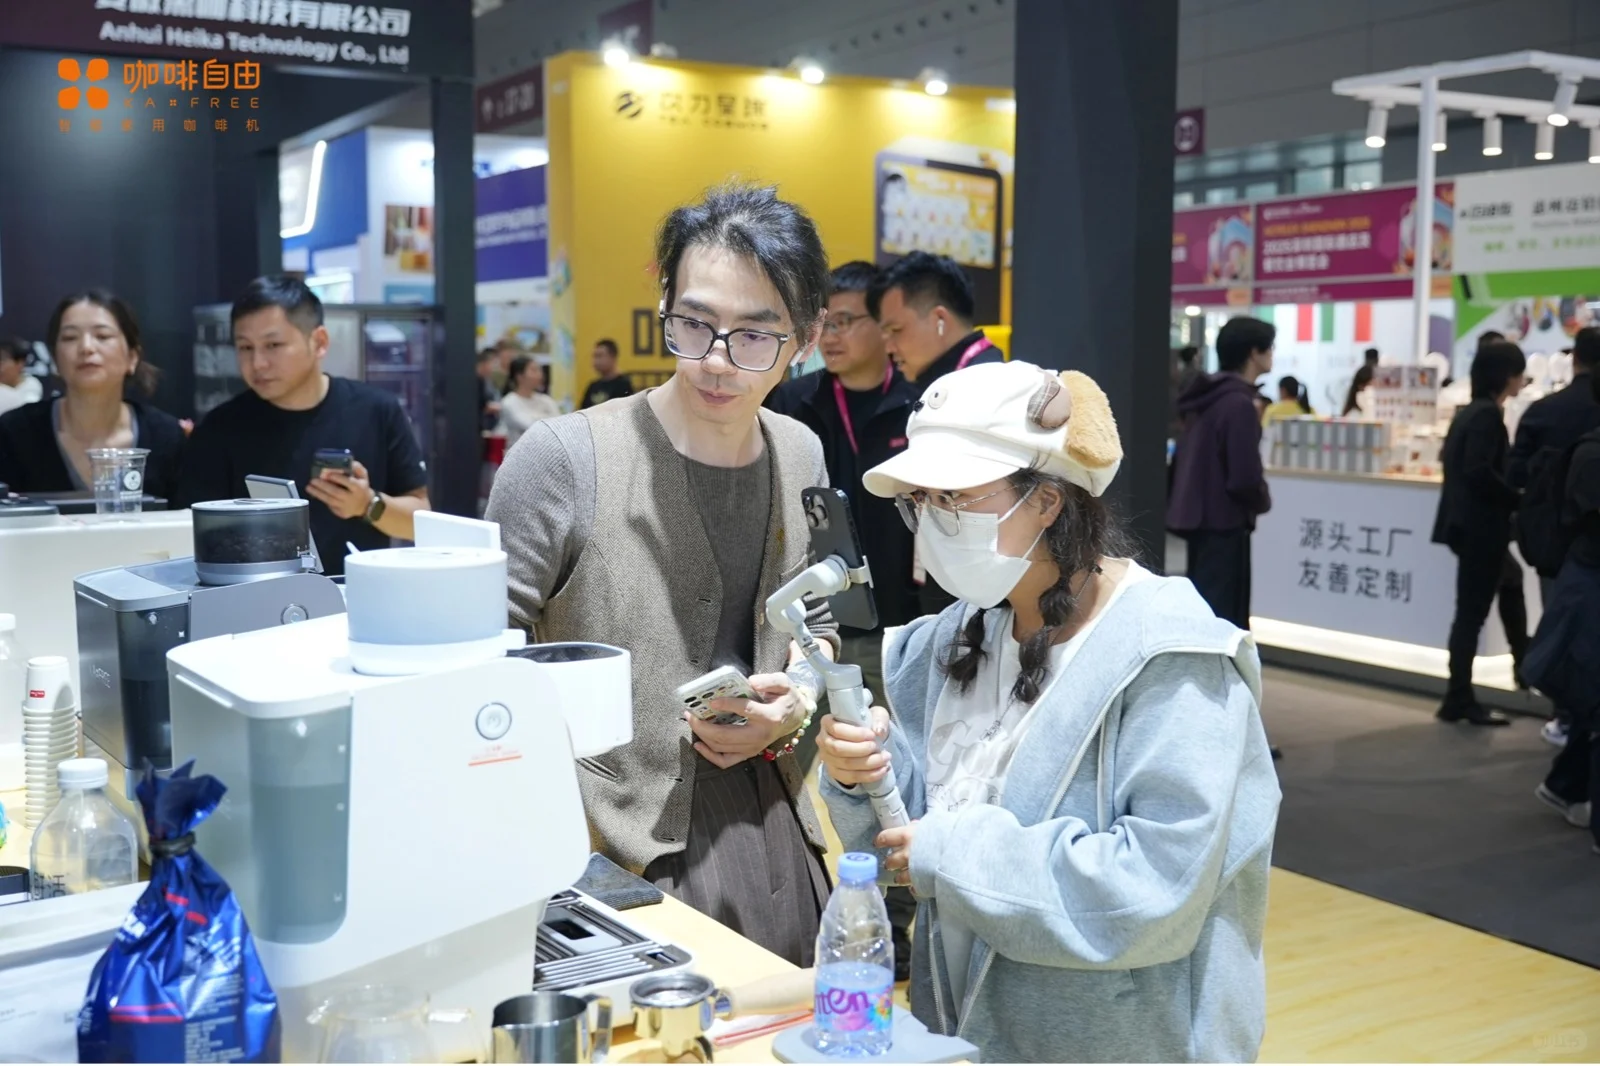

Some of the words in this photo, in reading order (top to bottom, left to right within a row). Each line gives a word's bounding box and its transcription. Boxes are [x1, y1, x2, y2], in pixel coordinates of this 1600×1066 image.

[99, 20, 163, 46] Anhui
[165, 25, 224, 50] Heika
[226, 31, 338, 62] Technology
[1299, 517, 1412, 557] 源头工厂
[1298, 558, 1412, 603] 友善定制
